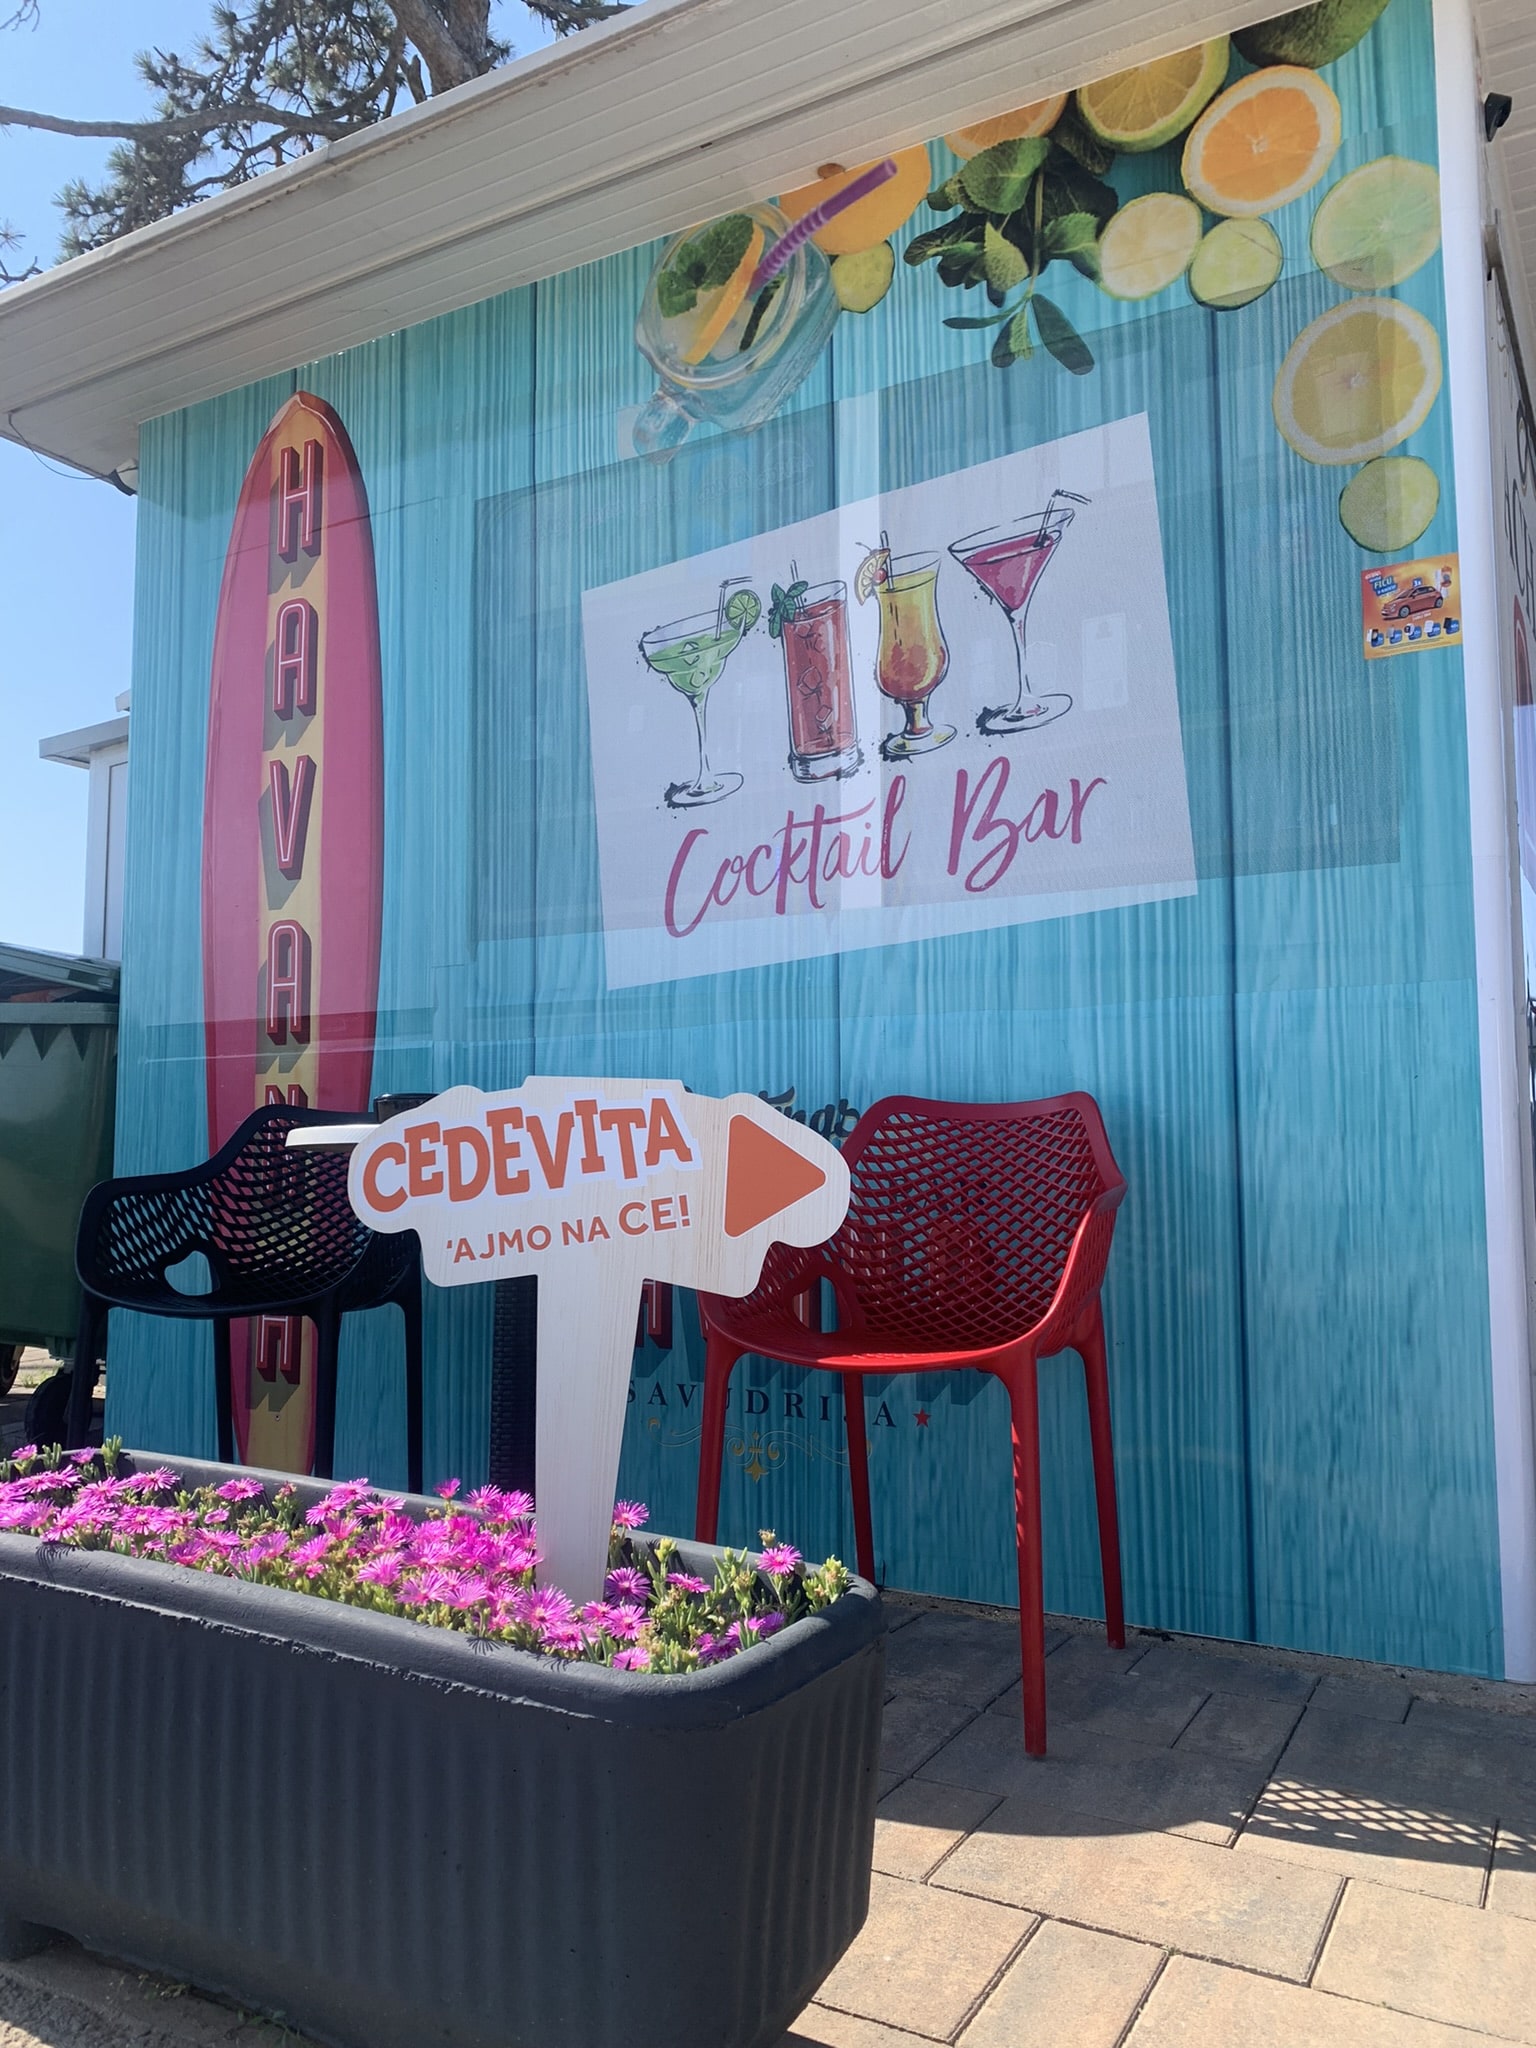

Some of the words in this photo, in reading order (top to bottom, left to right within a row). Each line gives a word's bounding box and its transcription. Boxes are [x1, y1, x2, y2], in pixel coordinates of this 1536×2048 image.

[664, 774, 911, 938] Cocktail
[947, 756, 1107, 892] Bar
[363, 1098, 693, 1213] CEDEVITA
[562, 1216, 611, 1246] NA
[618, 1195, 691, 1236] CE!
